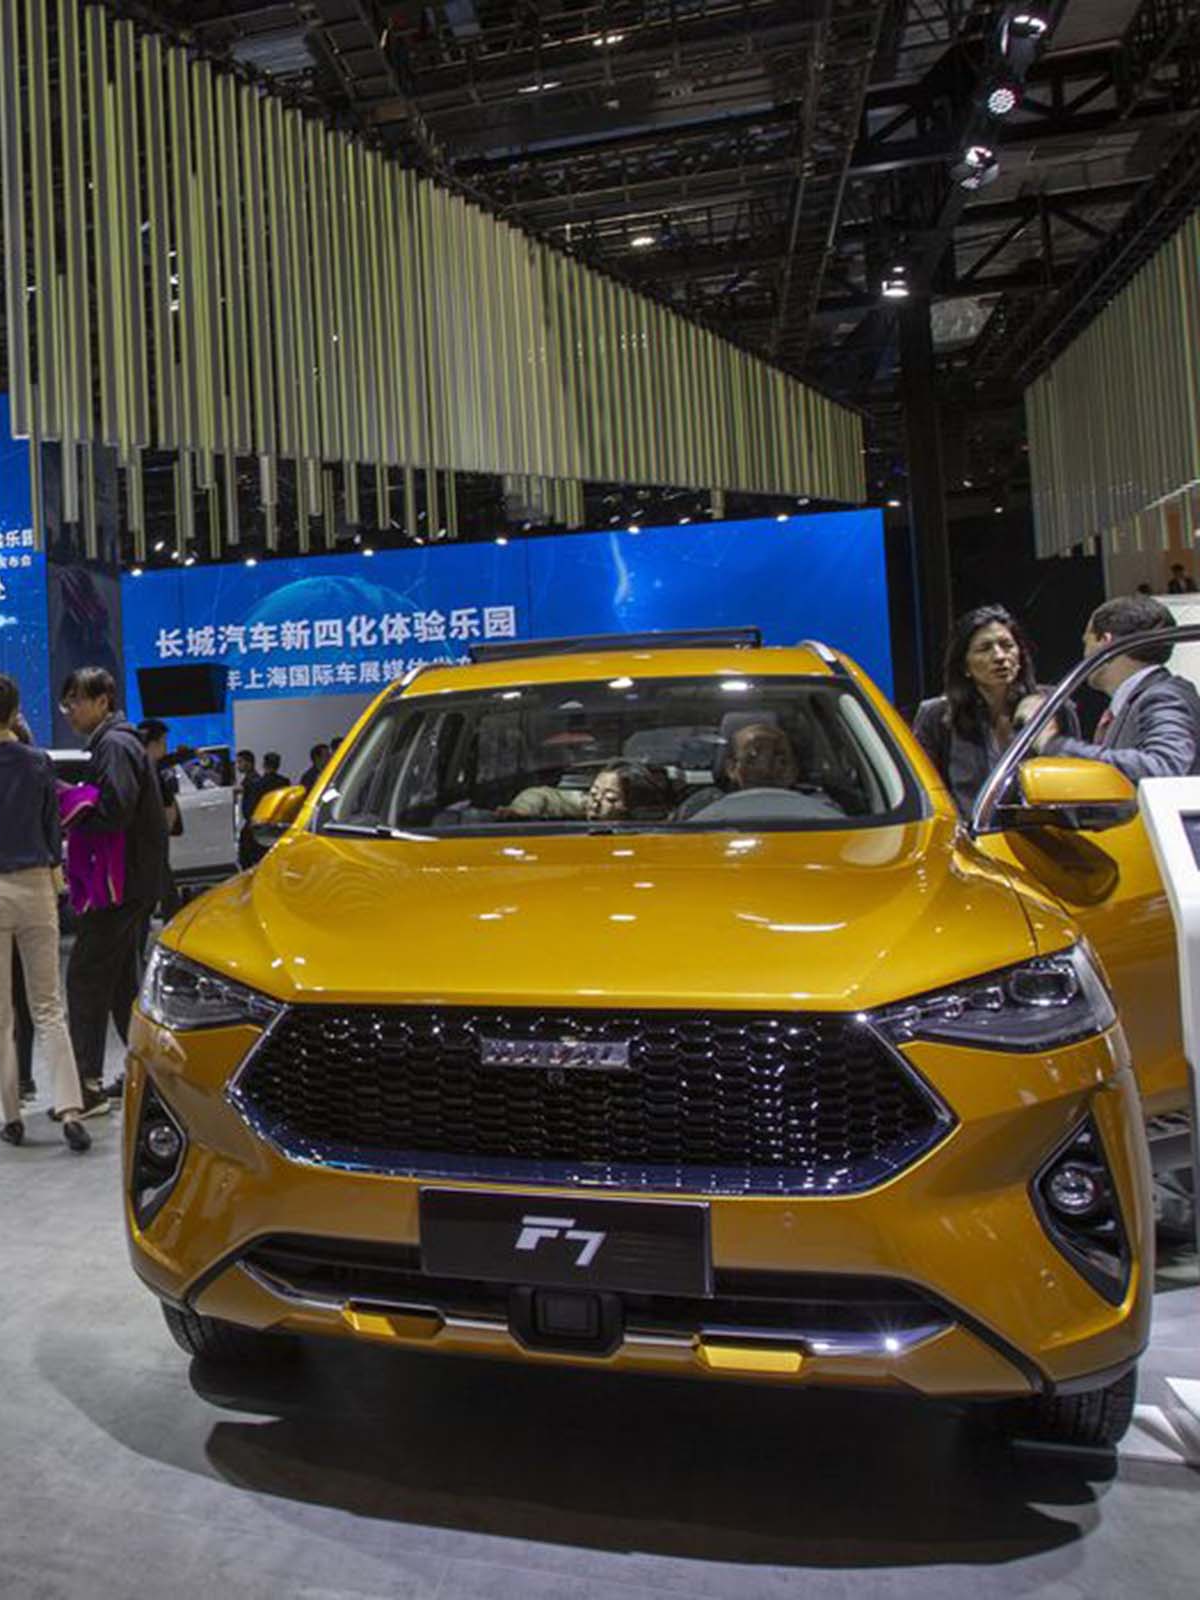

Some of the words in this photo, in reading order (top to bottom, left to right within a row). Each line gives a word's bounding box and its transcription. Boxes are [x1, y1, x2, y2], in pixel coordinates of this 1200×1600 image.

[155, 606, 517, 658] 长城汽车新四化体验乐园
[515, 1215, 606, 1267] F7
